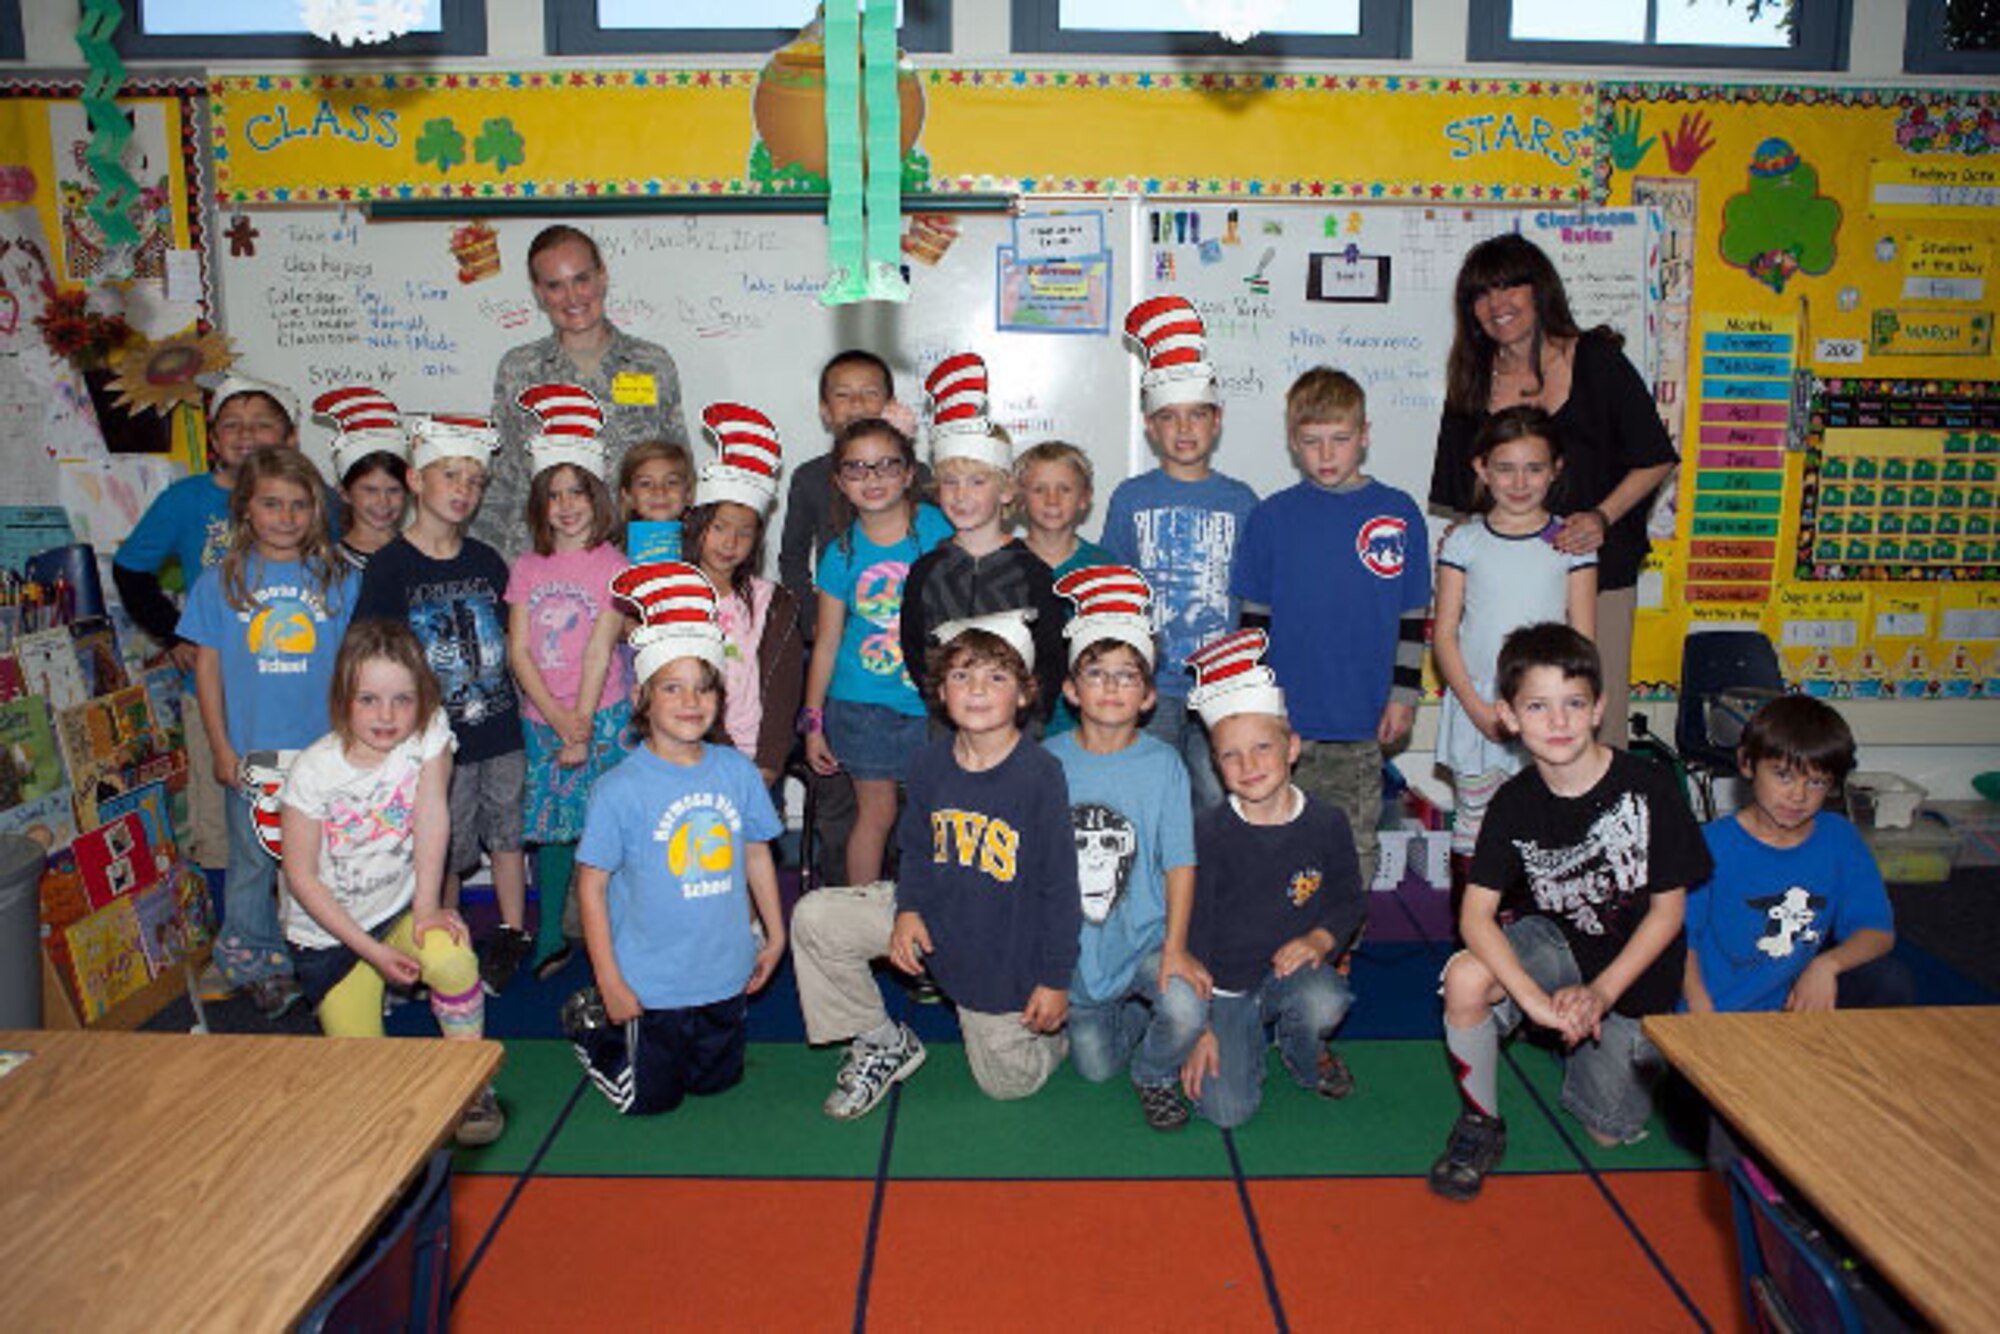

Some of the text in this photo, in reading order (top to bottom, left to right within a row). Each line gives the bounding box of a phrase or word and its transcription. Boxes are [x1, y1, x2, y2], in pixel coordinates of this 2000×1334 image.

[245, 101, 400, 151] CLASS
[1444, 113, 1582, 167] STARS
[1560, 227, 1613, 244] Rules
[1921, 243, 1974, 256] Student
[1725, 319, 1773, 332] Months
[1905, 323, 1961, 341] MARCH
[1823, 342, 1857, 358] 2012
[1728, 406, 1759, 421] April
[1727, 429, 1757, 444] May
[1726, 452, 1757, 467] June
[1725, 475, 1751, 490] July
[1714, 499, 1757, 515] August
[1700, 518, 1767, 534] September
[1706, 544, 1754, 555] October
[1696, 567, 1757, 579] November
[1695, 586, 1759, 600] December
[1826, 591, 1863, 603] School
[258, 658, 307, 671] School
[683, 875, 732, 898] School
